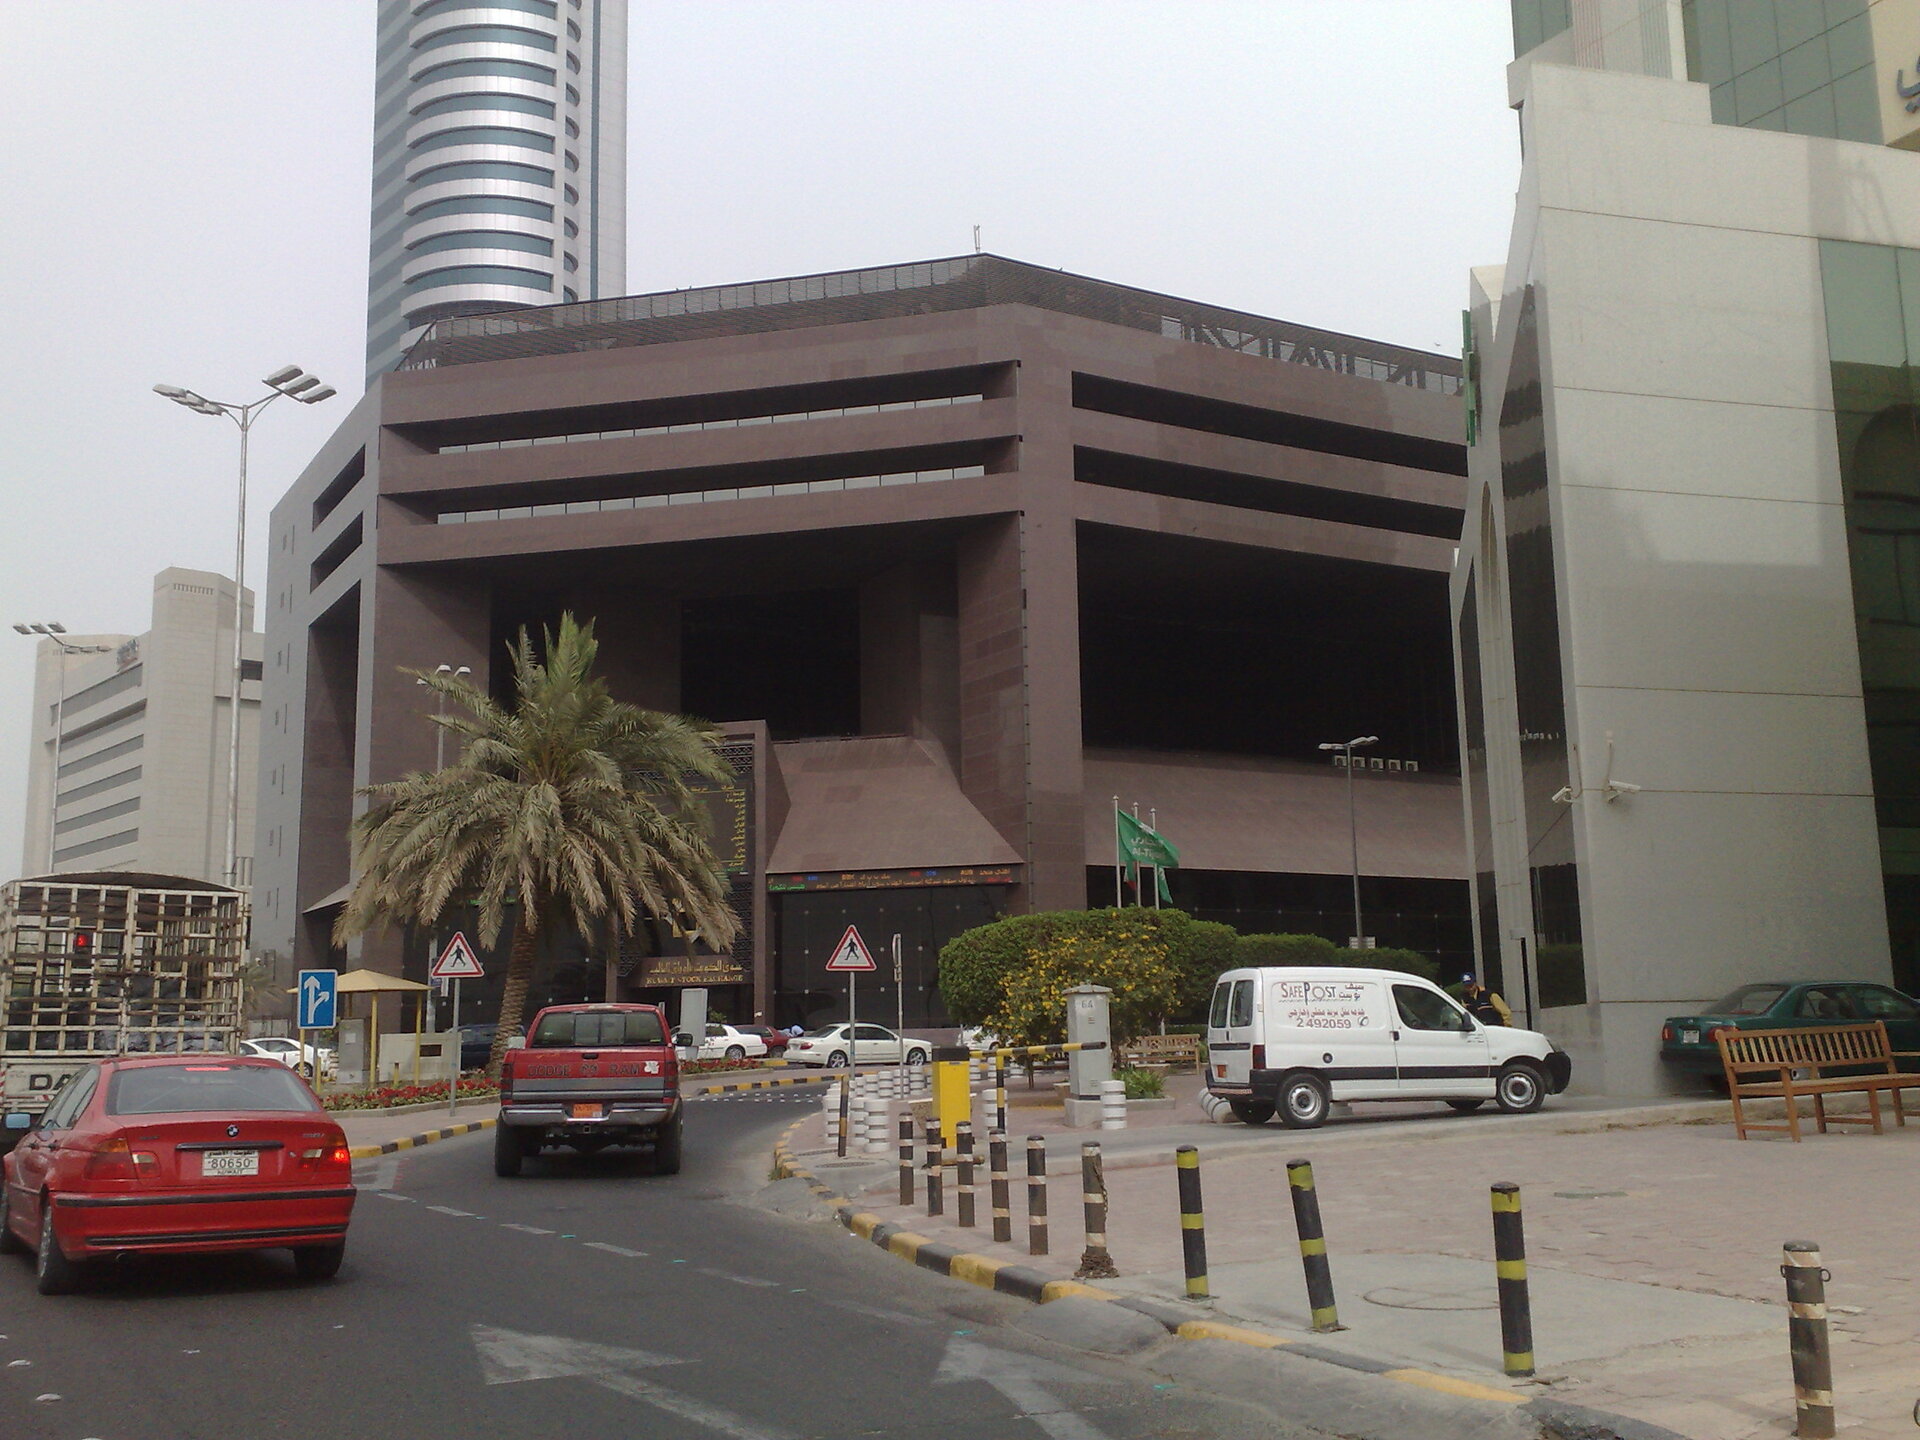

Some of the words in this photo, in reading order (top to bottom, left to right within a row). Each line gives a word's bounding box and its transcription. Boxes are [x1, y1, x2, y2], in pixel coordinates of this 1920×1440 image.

[1296, 1018, 1352, 1029] 2492059
[527, 1064, 571, 1077] DODGE
[608, 1063, 640, 1076] RAM
[210, 1158, 251, 1169] 80650
